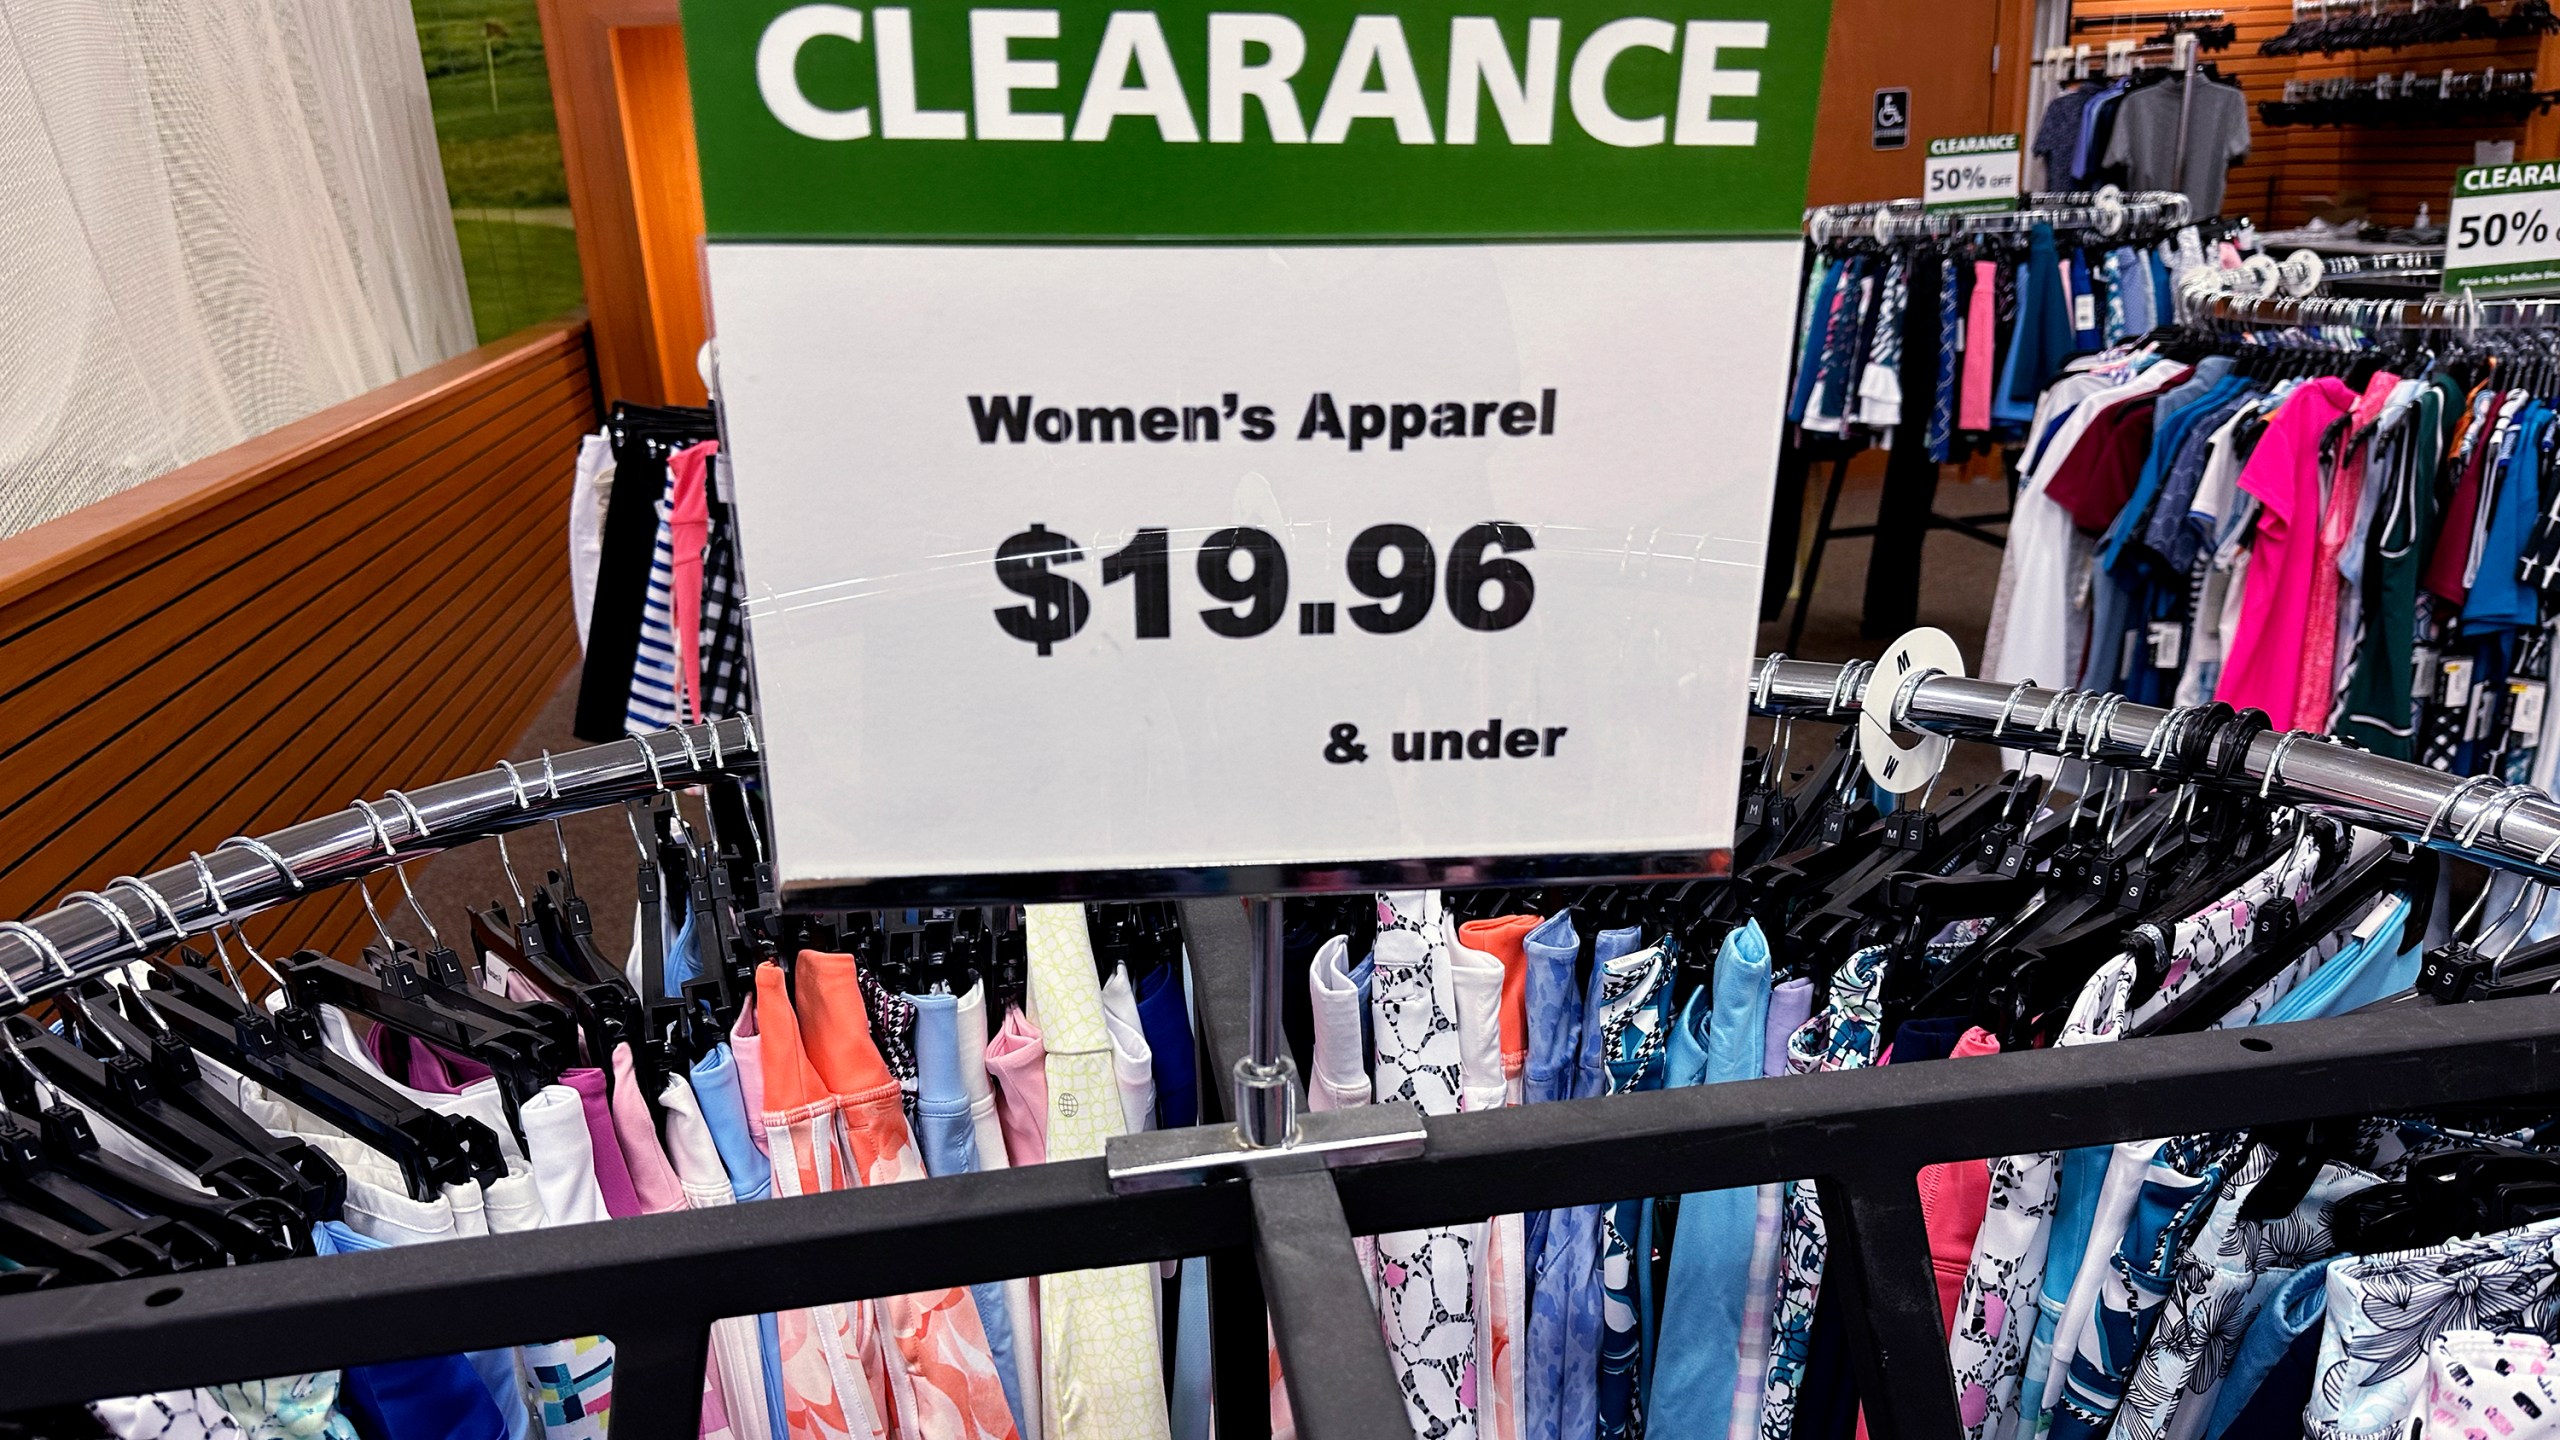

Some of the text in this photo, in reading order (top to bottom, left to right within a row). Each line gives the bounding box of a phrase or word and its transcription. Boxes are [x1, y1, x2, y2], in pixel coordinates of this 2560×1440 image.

[757, 4, 1771, 147] CLEARANCE
[1930, 134, 2016, 155] CLEARANCE
[1931, 164, 1986, 192] 50%
[2463, 163, 2560, 191] CLEARA
[2457, 208, 2548, 249] 50%
[967, 388, 1557, 452] Women's Apparel
[993, 521, 1536, 657] $19.96
[1896, 650, 1911, 676] M
[1323, 718, 1568, 765] & under
[1750, 804, 1758, 815] M
[1772, 817, 1780, 826] M
[1829, 822, 1838, 832] M
[1887, 829, 1897, 839] M
[1909, 830, 1917, 840] S
[1985, 844, 1993, 855] S
[2005, 856, 2016, 867] S
[2052, 867, 2061, 878] S
[2077, 866, 2086, 876] S
[717, 877, 725, 886] L
[762, 874, 768, 882] L
[2093, 875, 2102, 885] S
[645, 884, 653, 893] L
[2128, 886, 2139, 897] S
[698, 891, 707, 901] L
[576, 914, 584, 924] L
[2261, 921, 2270, 932] S
[528, 936, 538, 946] L
[446, 963, 457, 973] L
[2427, 964, 2437, 976] S
[403, 974, 413, 985] L
[2442, 972, 2454, 985] S
[260, 1034, 272, 1045] L
[302, 1029, 313, 1040] L
[134, 1079, 147, 1091] L
[74, 1126, 87, 1139] L
[24, 1149, 37, 1160] L
